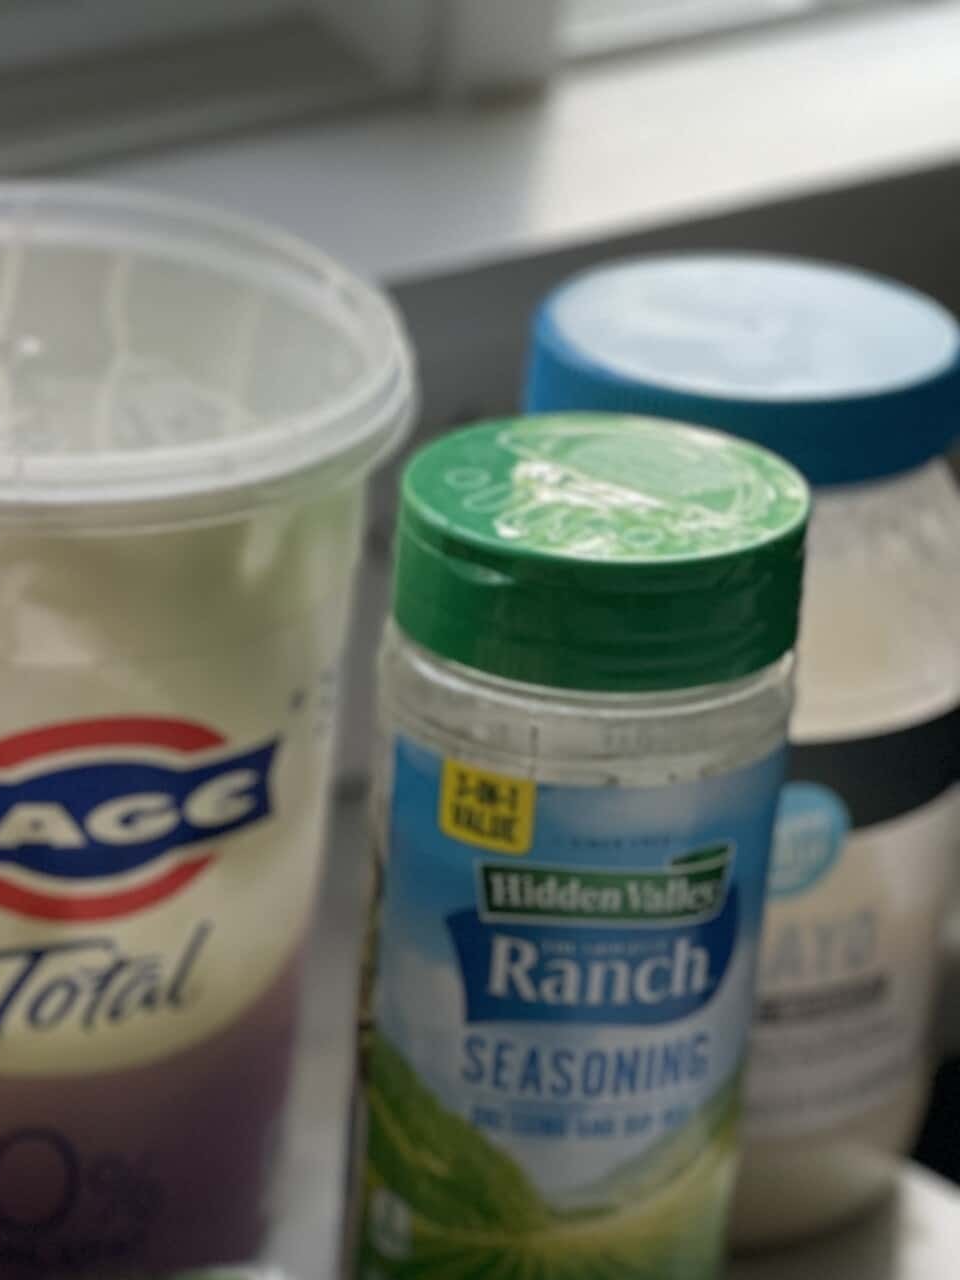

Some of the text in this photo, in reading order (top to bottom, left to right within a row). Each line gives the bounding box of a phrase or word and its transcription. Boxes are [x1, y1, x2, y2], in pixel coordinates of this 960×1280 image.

[453, 802, 520, 844] VALUE
[487, 872, 623, 914] Hidden
[488, 933, 712, 1008] Ranch
[460, 1034, 712, 1096] SEASONING
